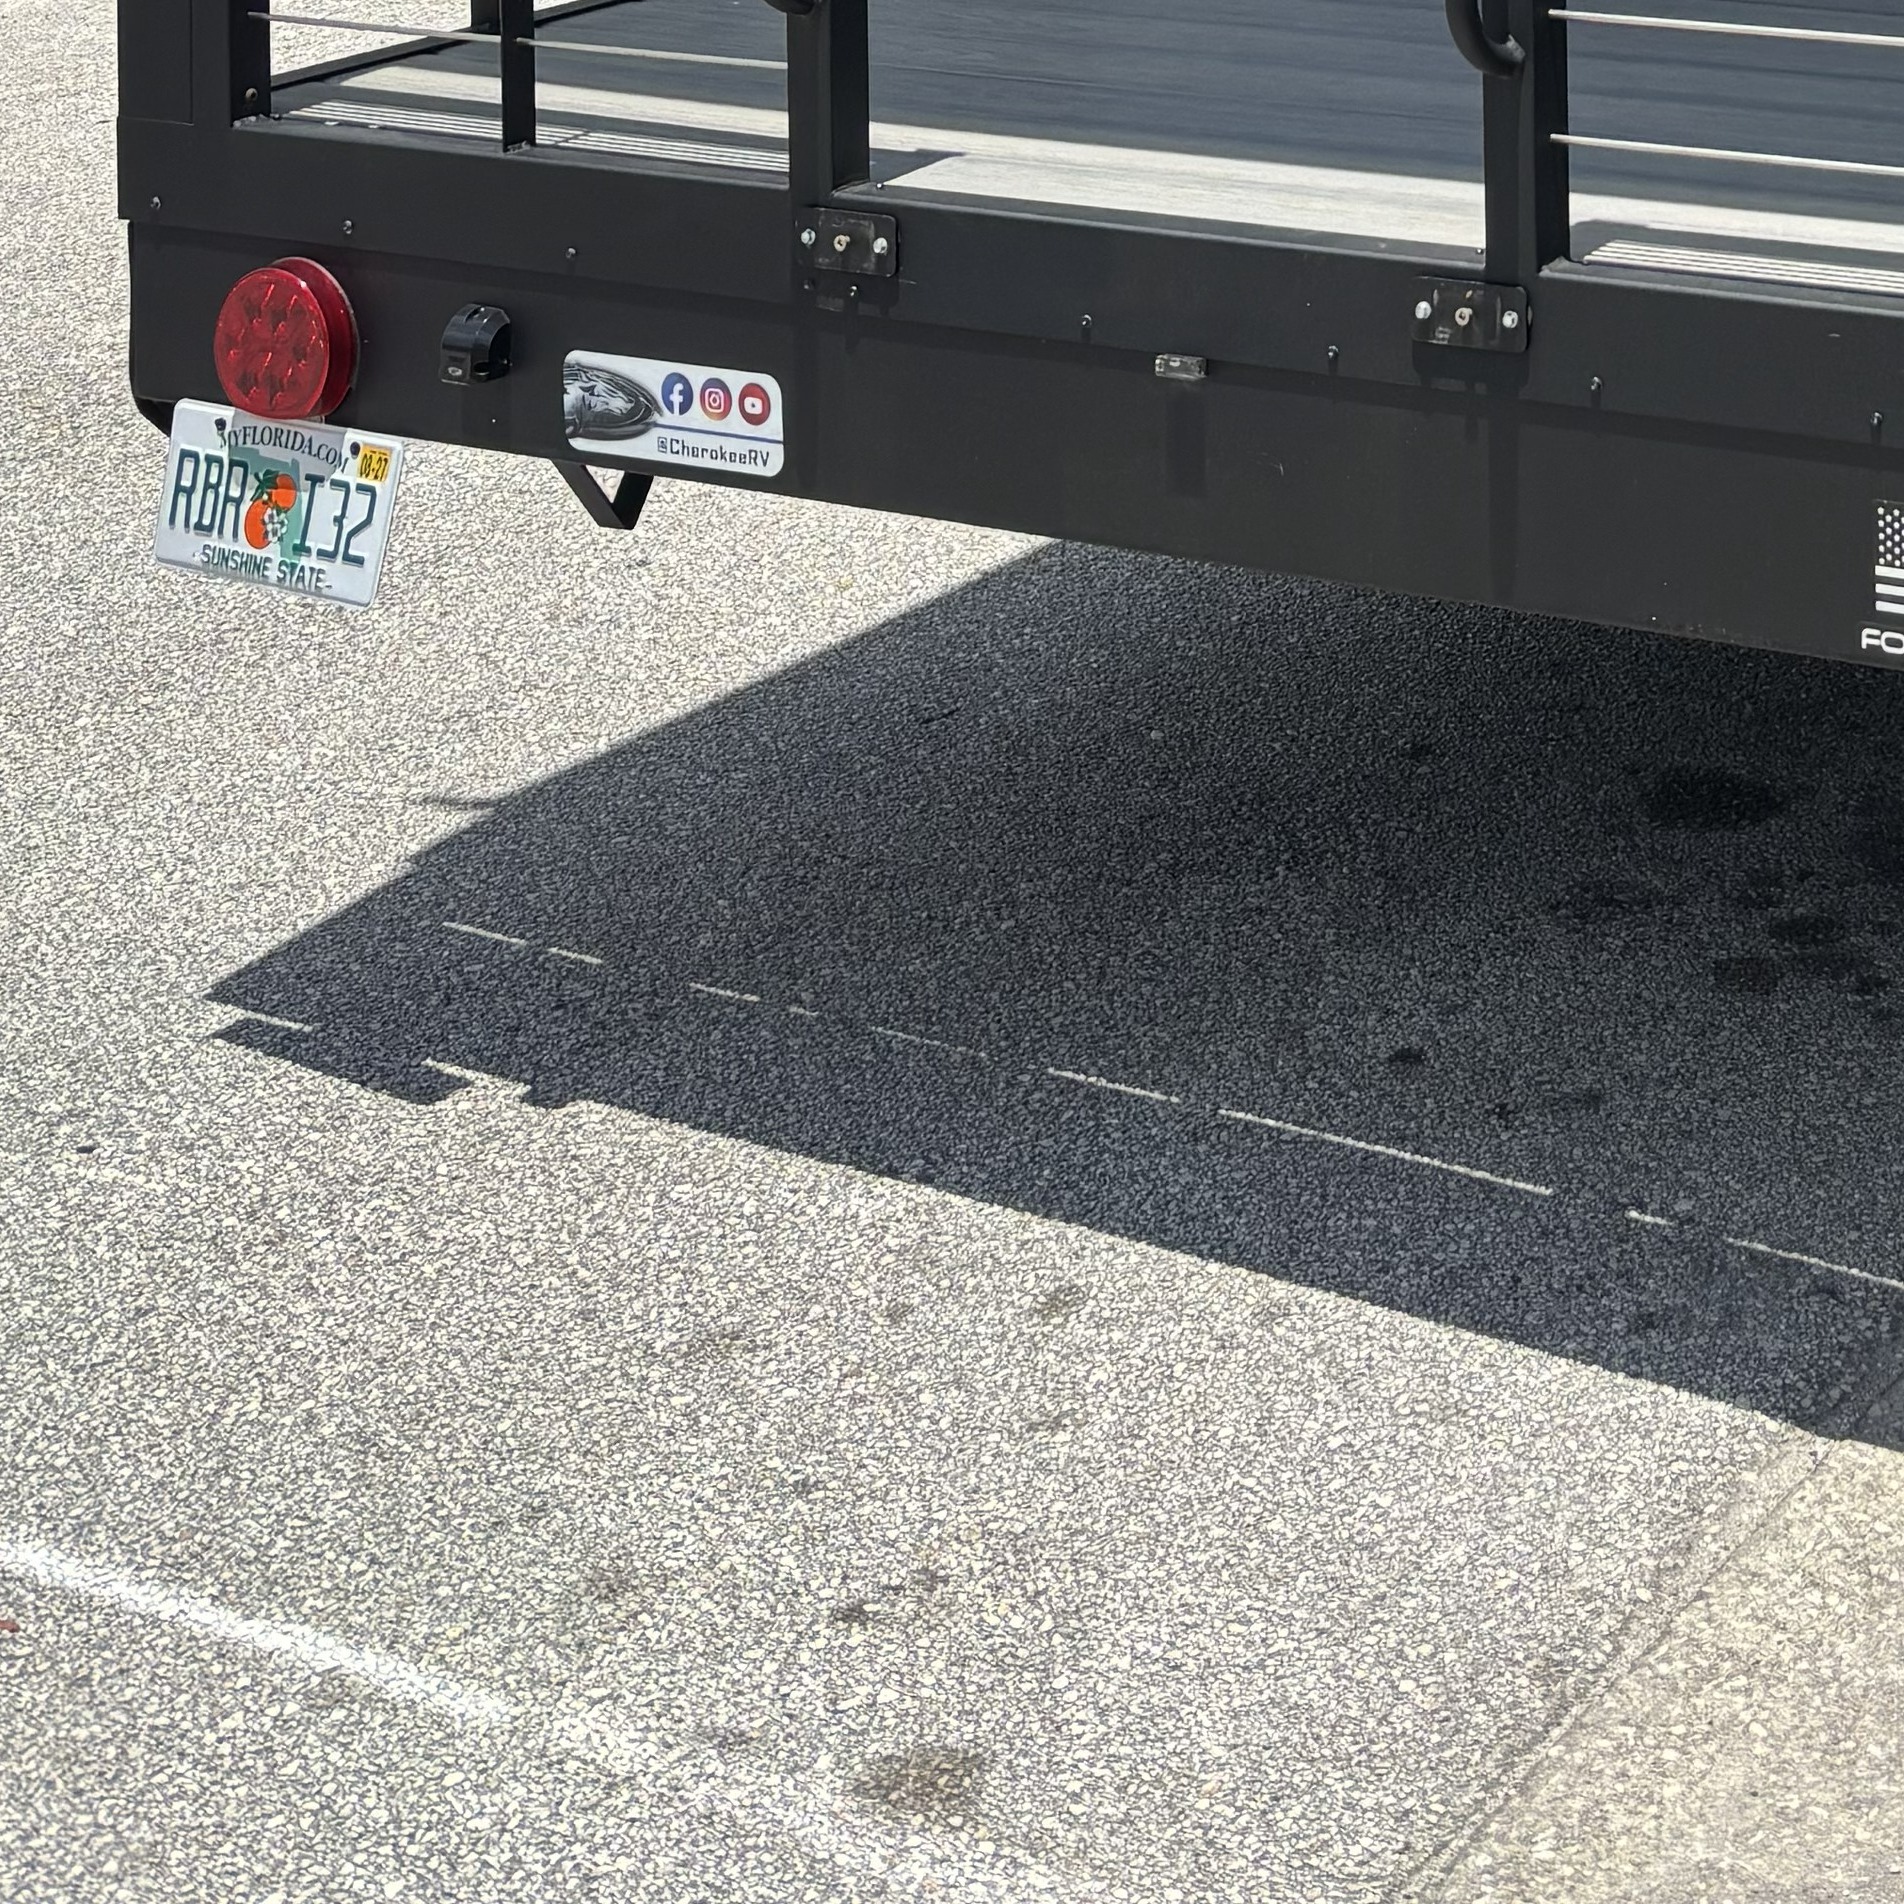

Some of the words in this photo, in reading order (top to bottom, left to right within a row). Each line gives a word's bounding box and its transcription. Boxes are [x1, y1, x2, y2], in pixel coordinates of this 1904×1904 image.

[169, 448, 249, 541] RBR
[201, 544, 273, 580] SUNSHINE
[277, 559, 326, 591] STATE
